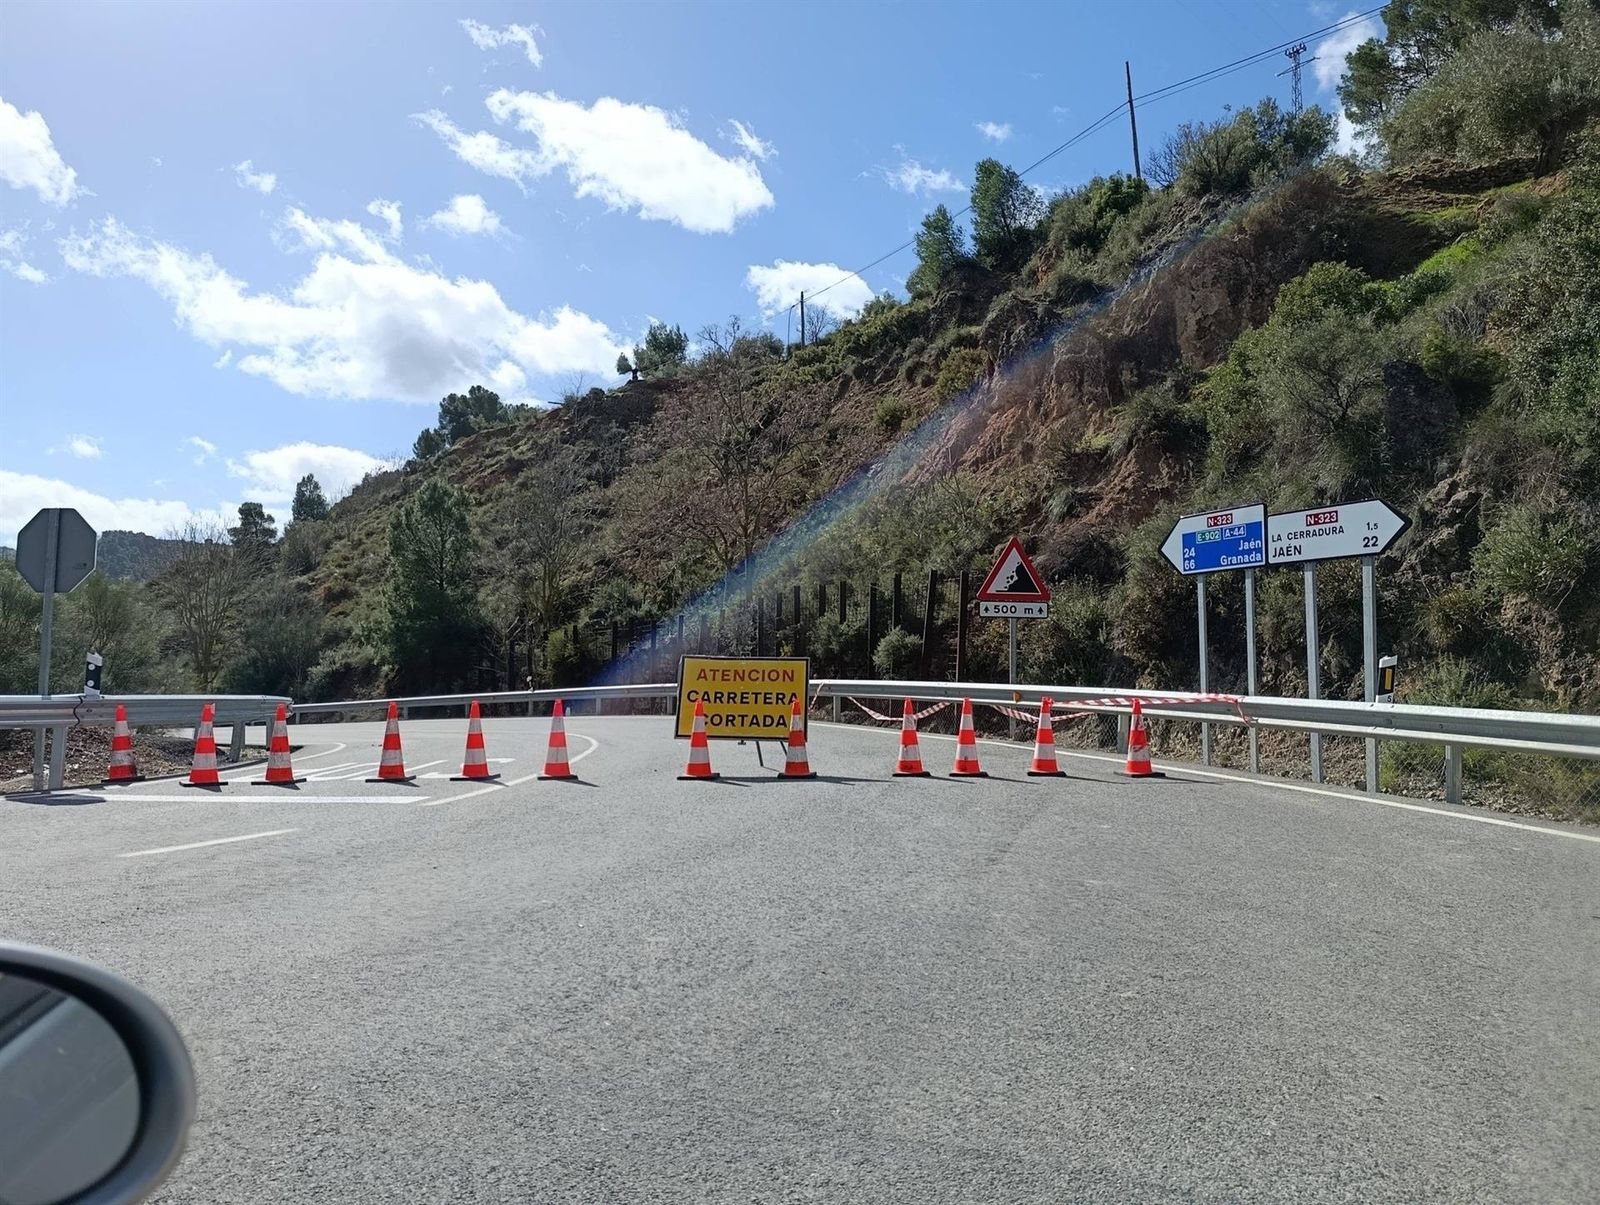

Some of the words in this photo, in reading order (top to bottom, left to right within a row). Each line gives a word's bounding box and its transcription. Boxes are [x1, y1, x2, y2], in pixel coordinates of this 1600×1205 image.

[1208, 515, 1232, 526] N-323
[1307, 512, 1337, 525] N-323
[1197, 531, 1220, 542] E-902
[1225, 527, 1245, 537] A-44
[1271, 534, 1283, 543] LA
[1287, 525, 1345, 541] CERRADURA
[1183, 547, 1196, 558] 24
[1238, 538, 1262, 551] Jaén
[1272, 543, 1302, 558] JAÉN
[1362, 536, 1379, 548] 22
[1184, 559, 1196, 570] 66
[1220, 551, 1262, 565] Granada
[993, 605, 1017, 614] 500
[696, 668, 795, 682] ATENCION
